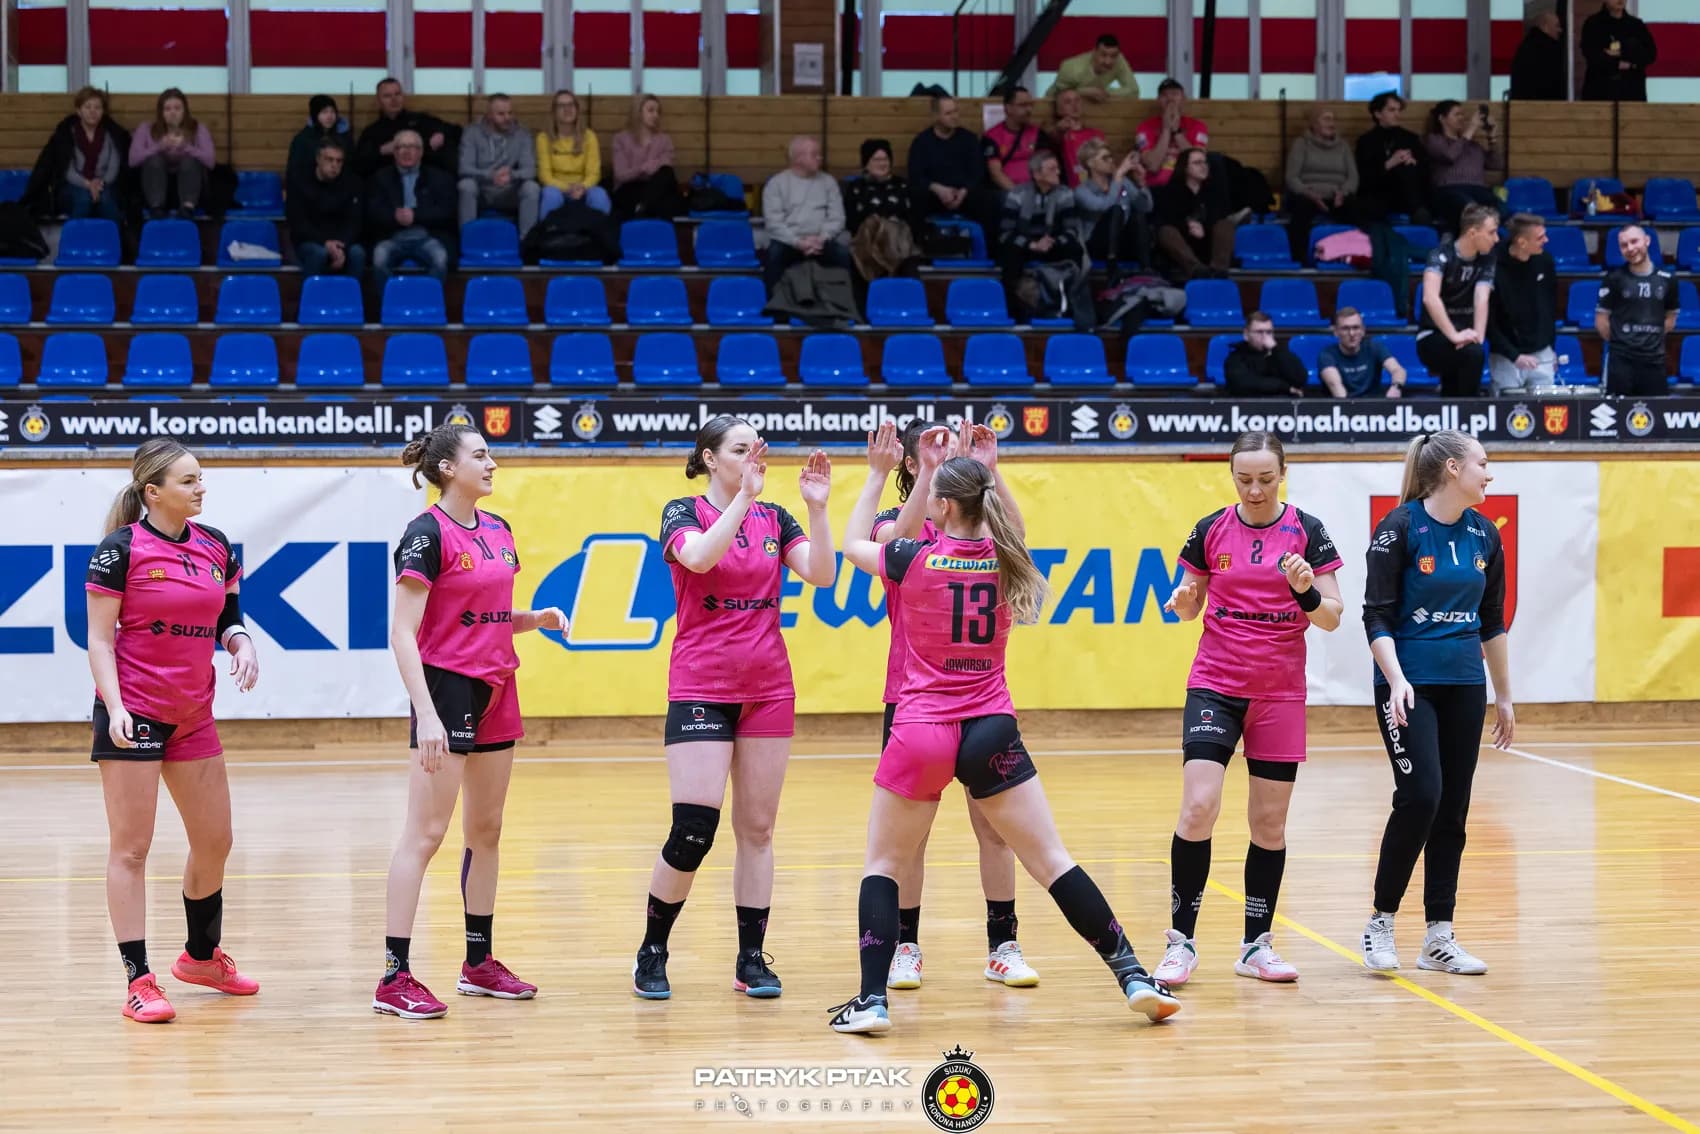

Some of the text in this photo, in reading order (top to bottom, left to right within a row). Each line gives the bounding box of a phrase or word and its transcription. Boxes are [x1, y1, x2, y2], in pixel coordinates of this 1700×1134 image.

[1637, 282, 1651, 298] 73
[61, 406, 433, 441] www.koronahandball.pl
[1147, 405, 1496, 438] www.koronahandball.pl
[176, 552, 199, 577] 11
[1250, 539, 1263, 565] 2
[1448, 541, 1459, 566] 1
[949, 559, 1000, 571] LEWIATA
[948, 582, 998, 645] 13
[1231, 610, 1297, 624] SUZUKI
[943, 658, 992, 672] JAWORSKA
